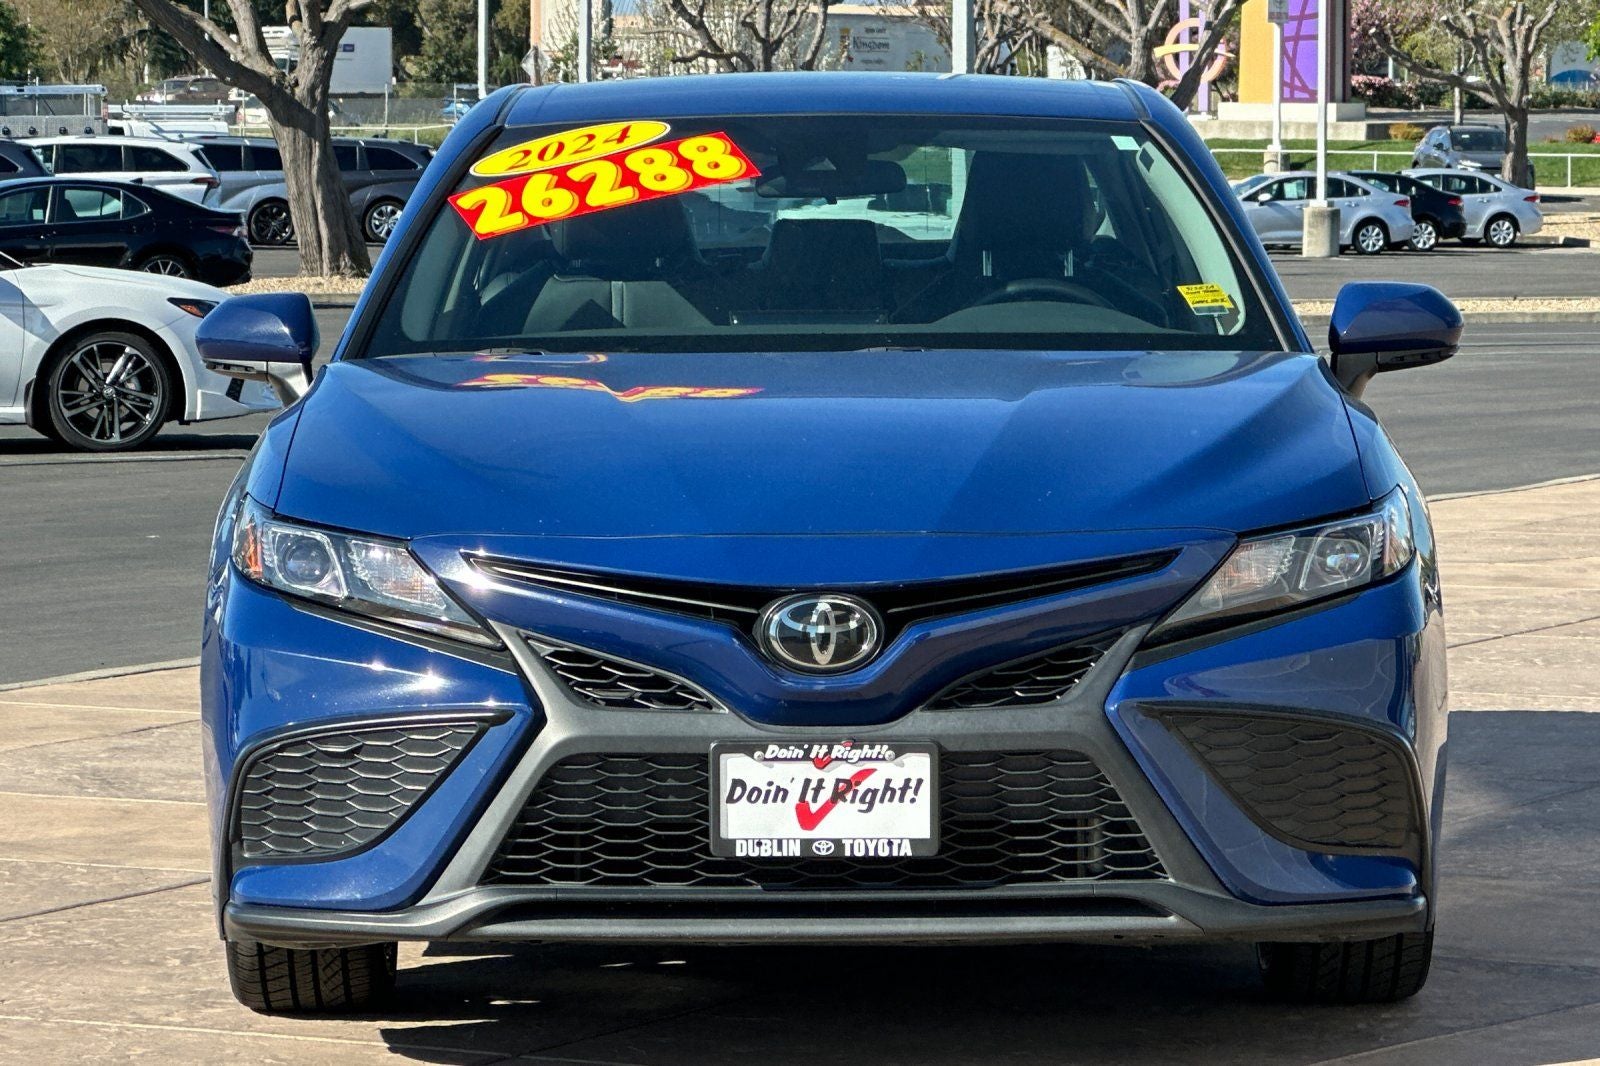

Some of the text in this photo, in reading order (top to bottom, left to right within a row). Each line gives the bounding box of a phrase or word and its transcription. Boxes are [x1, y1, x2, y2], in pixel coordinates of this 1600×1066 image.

[504, 124, 631, 171] 2024
[457, 135, 747, 234] 26288
[764, 744, 888, 764] Doin' It Right!
[726, 777, 924, 814] Doin' It Right!
[735, 839, 912, 857] DUBLIN TOYOTA
